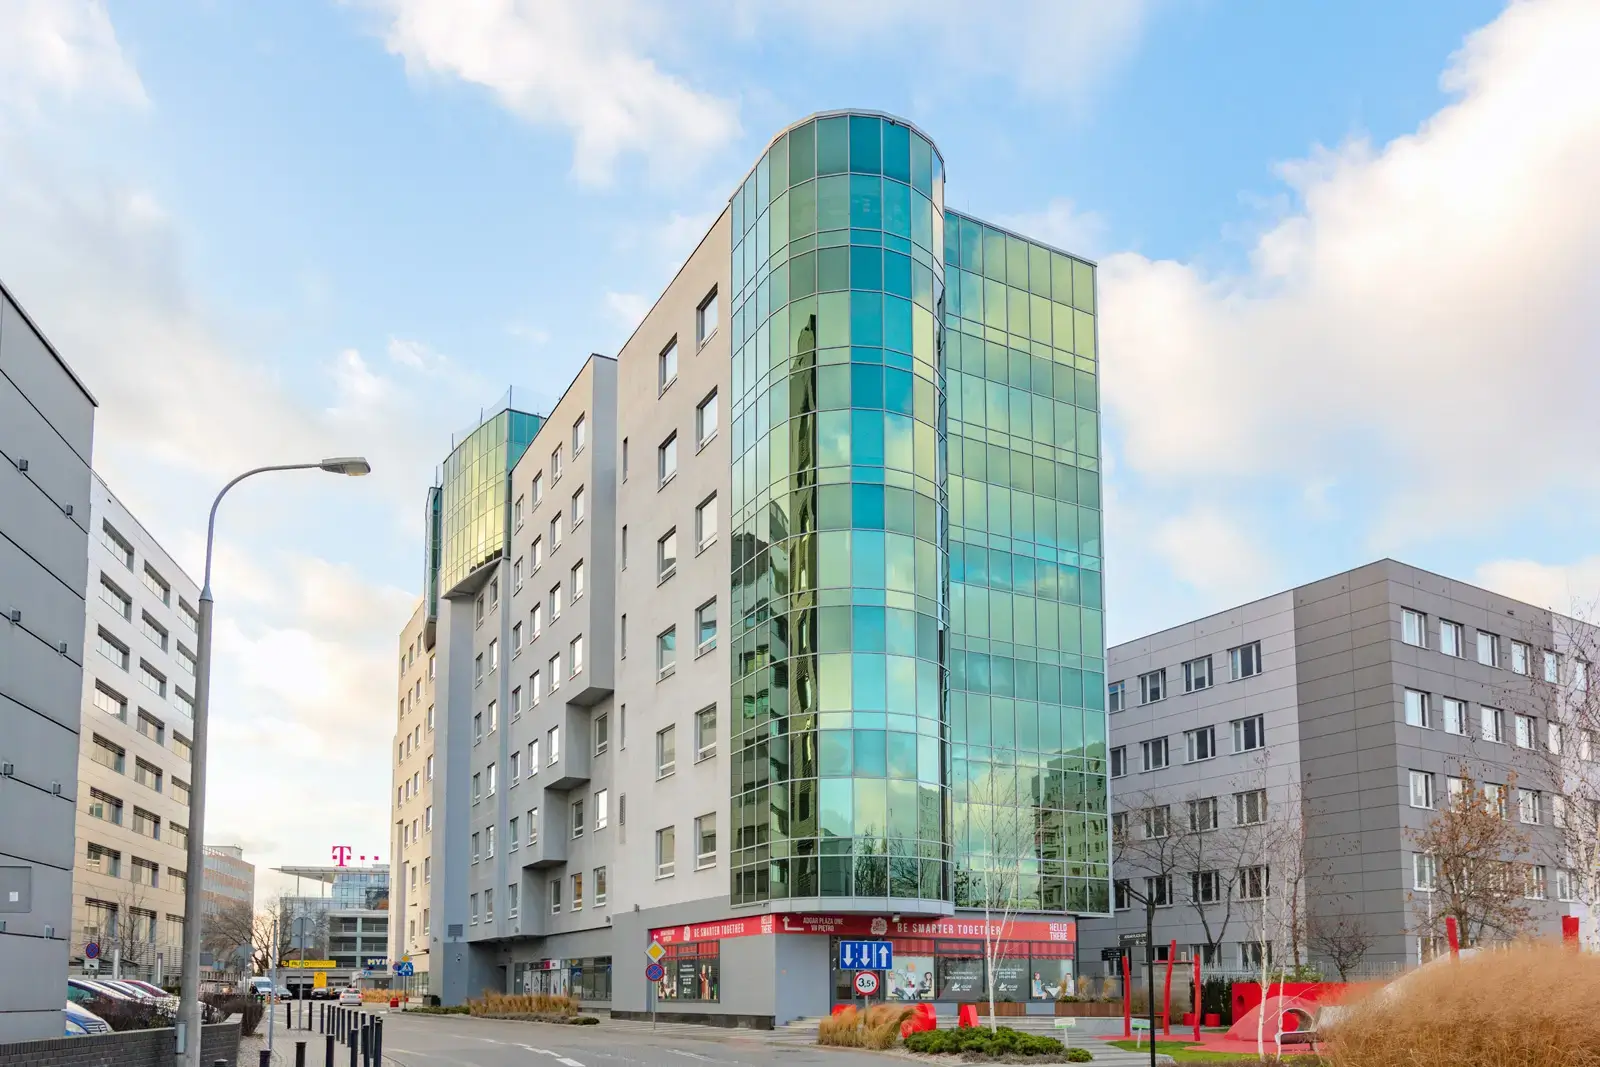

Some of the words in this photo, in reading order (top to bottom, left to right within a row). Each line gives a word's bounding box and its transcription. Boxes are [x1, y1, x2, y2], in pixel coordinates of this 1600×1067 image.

[761, 914, 773, 925] HELLO
[819, 917, 833, 925] PLAZA
[694, 928, 700, 938] BE
[700, 925, 720, 937] SMARTER
[721, 923, 745, 935] TOGETHER
[761, 925, 773, 934] THERE
[897, 923, 908, 933] BE
[912, 923, 954, 935] SMARTER
[1050, 923, 1067, 932] HELLO
[1050, 931, 1067, 941] THERE
